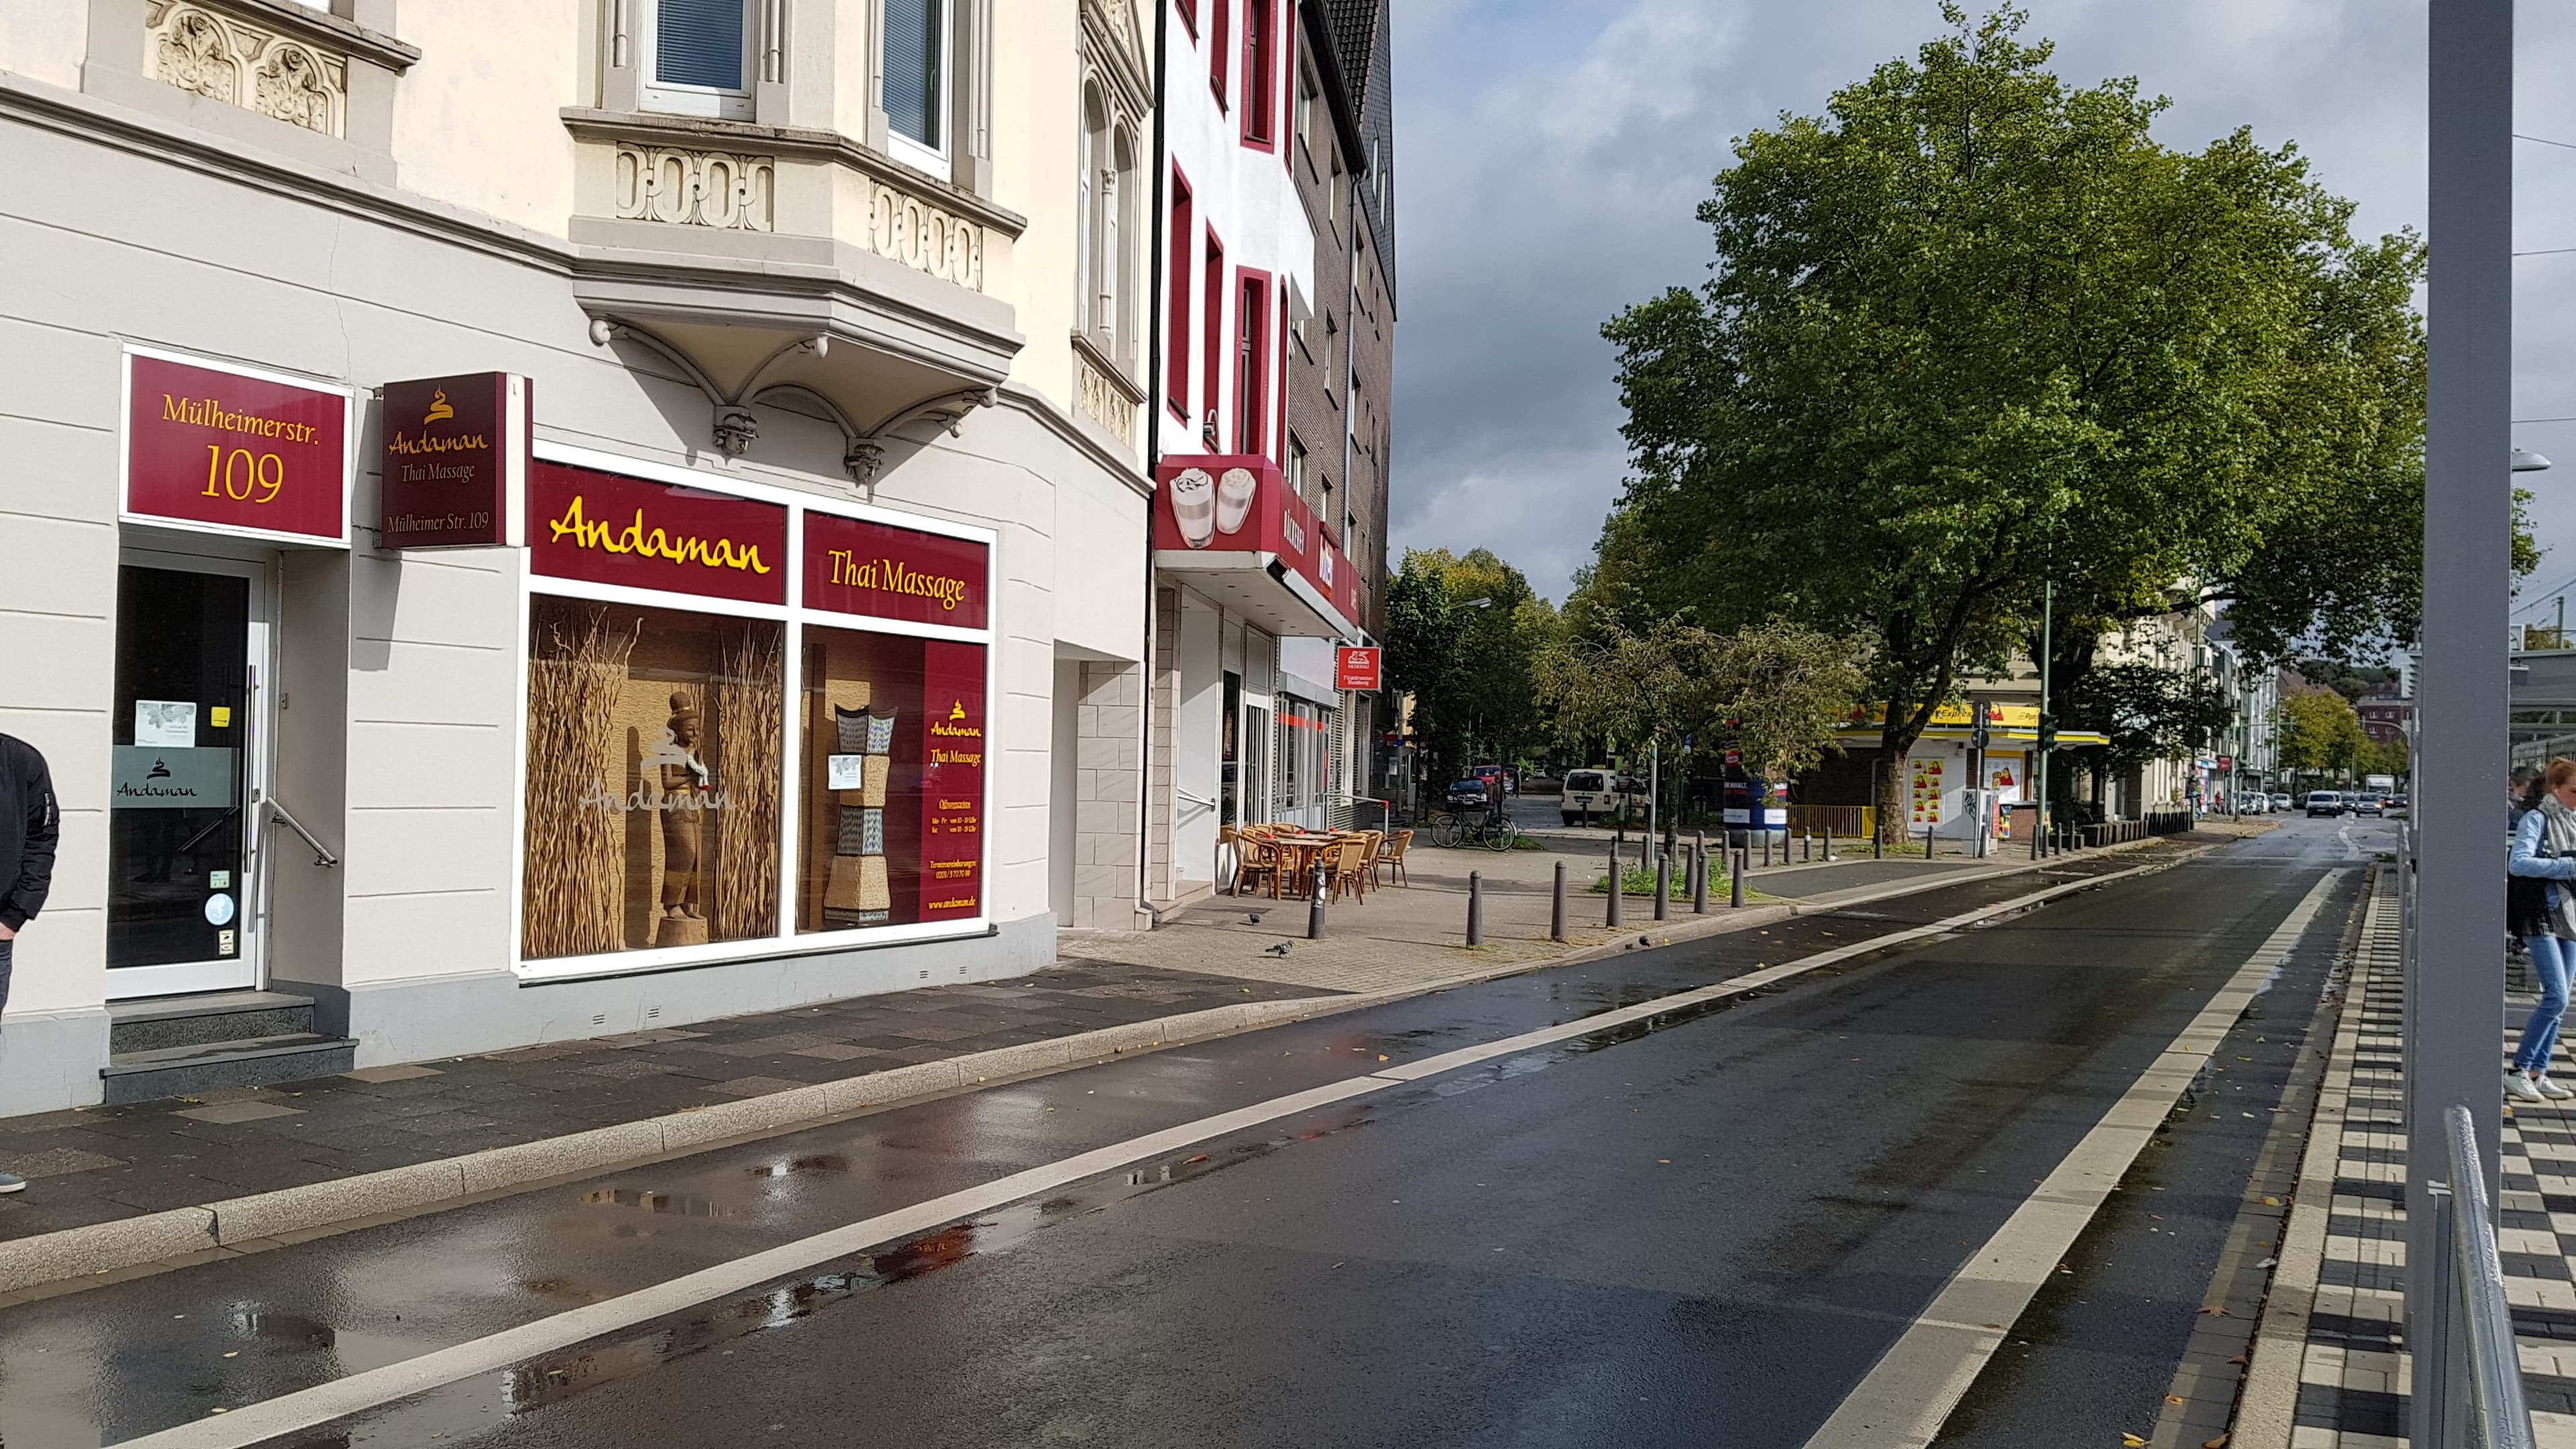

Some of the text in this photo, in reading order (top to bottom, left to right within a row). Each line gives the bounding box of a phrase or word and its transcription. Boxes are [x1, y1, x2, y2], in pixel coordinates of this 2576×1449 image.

[162, 394, 319, 445] Mülheimerstr.
[388, 429, 489, 456] Andaman
[201, 444, 283, 504] 109
[402, 464, 475, 484] Thai Massage
[388, 511, 489, 533] Mülheimer Str. 109
[549, 495, 770, 575] Andaman
[828, 549, 965, 611] Thai Massage
[930, 721, 981, 737] Andaman
[930, 749, 981, 767] Thai Massage
[117, 782, 197, 798] Andaman
[578, 777, 738, 813] Andaman
